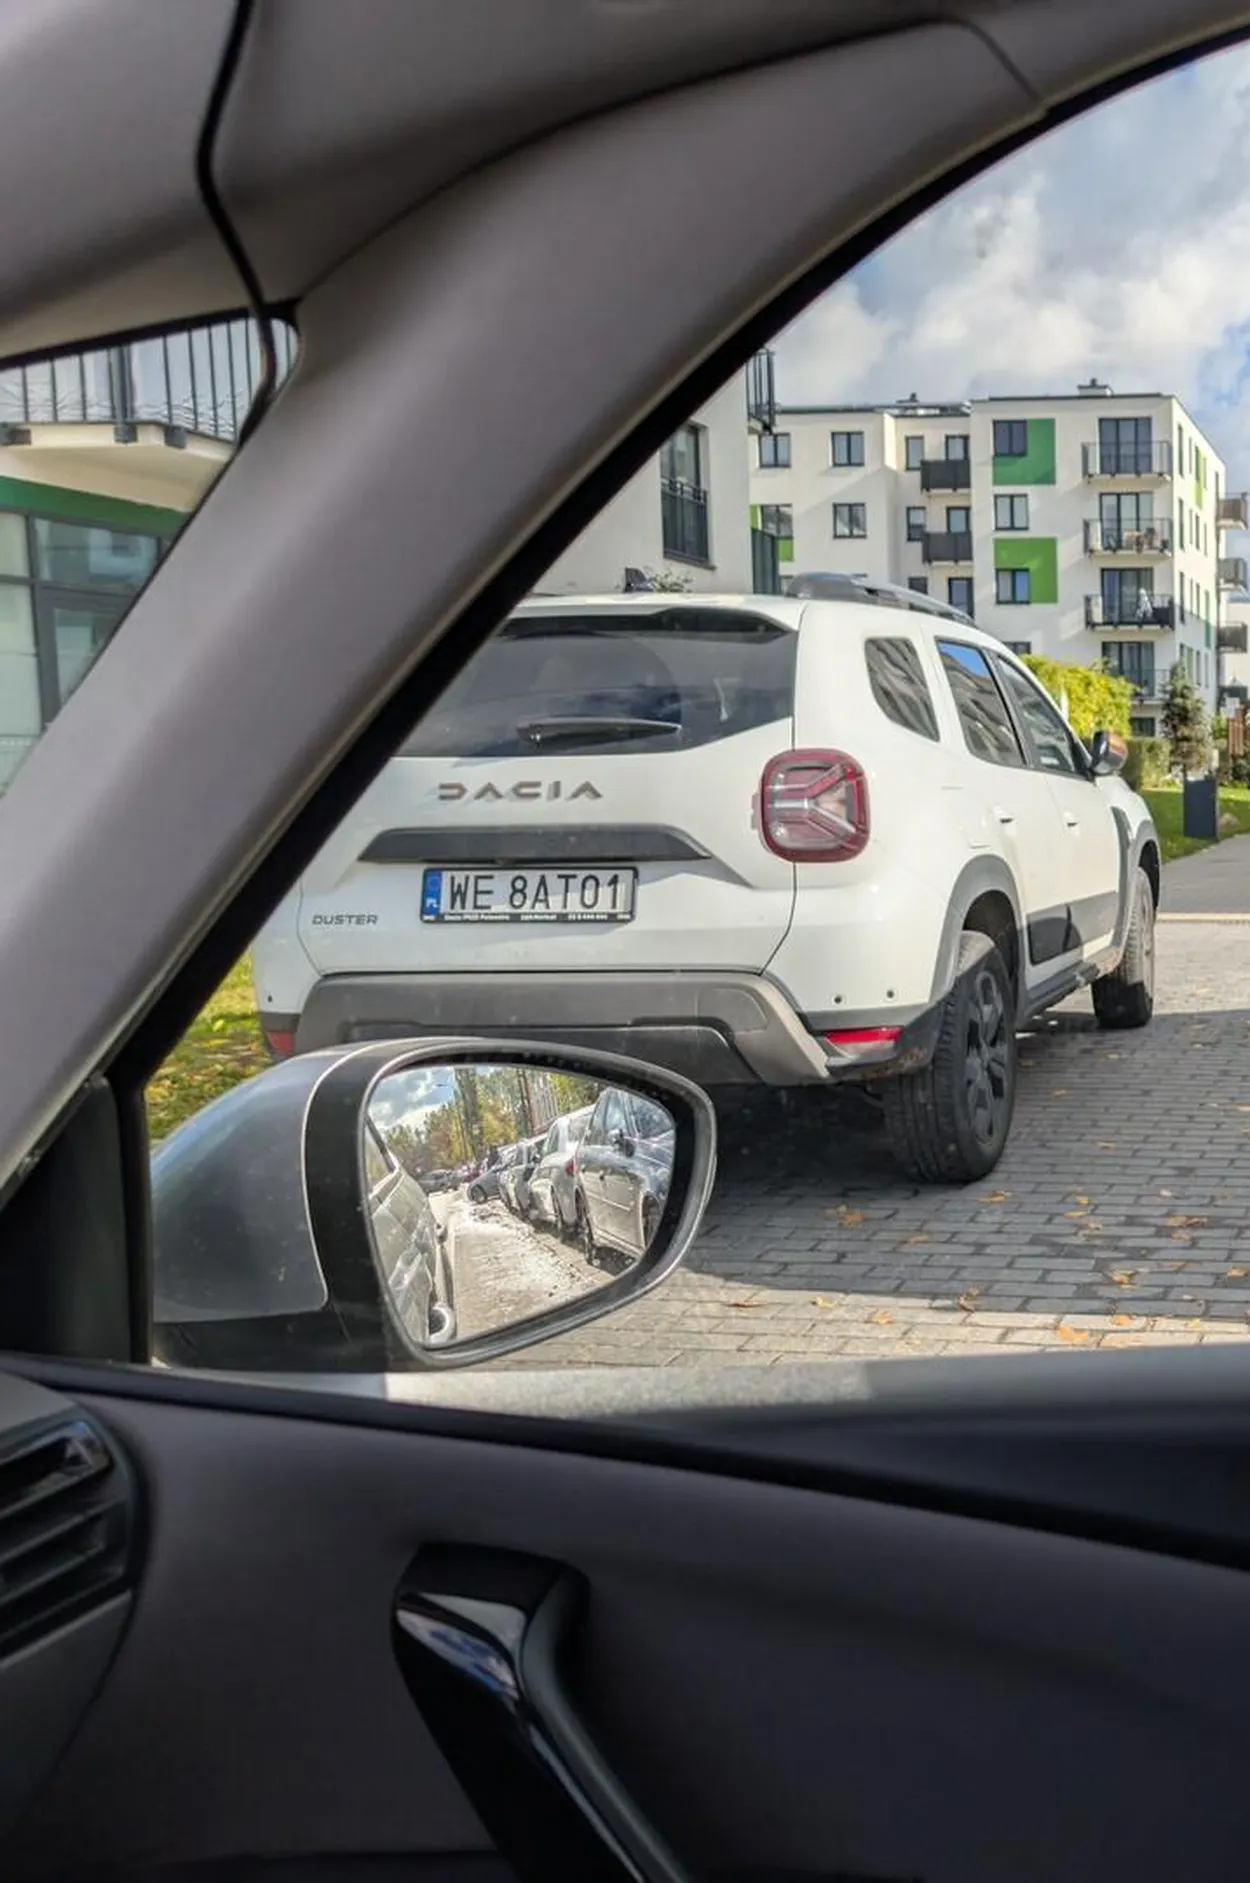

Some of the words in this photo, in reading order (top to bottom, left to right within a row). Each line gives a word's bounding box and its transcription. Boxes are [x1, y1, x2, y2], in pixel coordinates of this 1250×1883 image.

[438, 780, 603, 800] DACIA
[449, 874, 495, 911] WE
[509, 873, 620, 911] 8AT01
[311, 914, 378, 925] DUSTER
